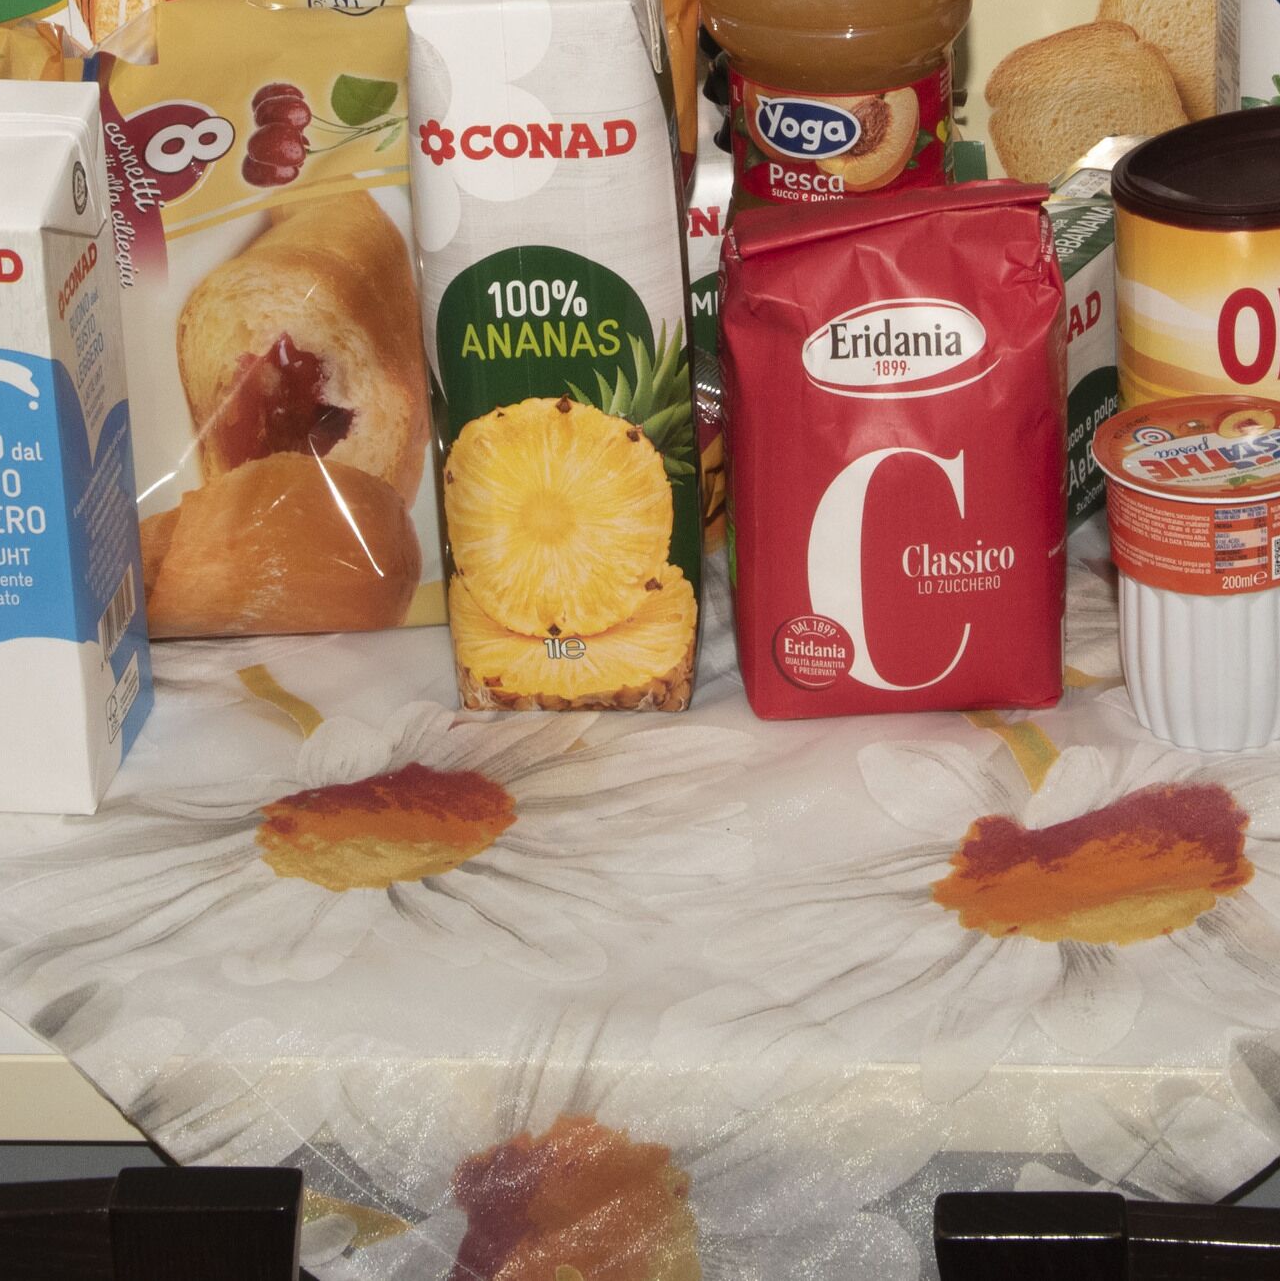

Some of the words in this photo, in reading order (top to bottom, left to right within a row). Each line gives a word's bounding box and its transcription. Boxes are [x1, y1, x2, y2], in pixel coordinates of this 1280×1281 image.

[144, 116, 236, 173] 8
[460, 118, 638, 160] CONAD
[761, 101, 848, 152] Yoga
[104, 121, 165, 214] cornetti
[768, 163, 845, 193] Pesca
[770, 188, 800, 201] succo
[801, 191, 809, 202] e
[64, 241, 99, 300] CONAD
[486, 278, 588, 320] 100%
[461, 318, 622, 361] ANANAS
[828, 317, 964, 362] Eridania
[11, 441, 44, 462] dal
[1153, 436, 1210, 458] pesca
[806, 445, 972, 692] C
[901, 539, 1016, 578] Classico
[917, 578, 933, 595] LO
[936, 573, 1002, 594] ZUCCHERO
[783, 637, 847, 660] Eridania
[791, 621, 812, 637] DAL
[810, 621, 837, 638] 1899
